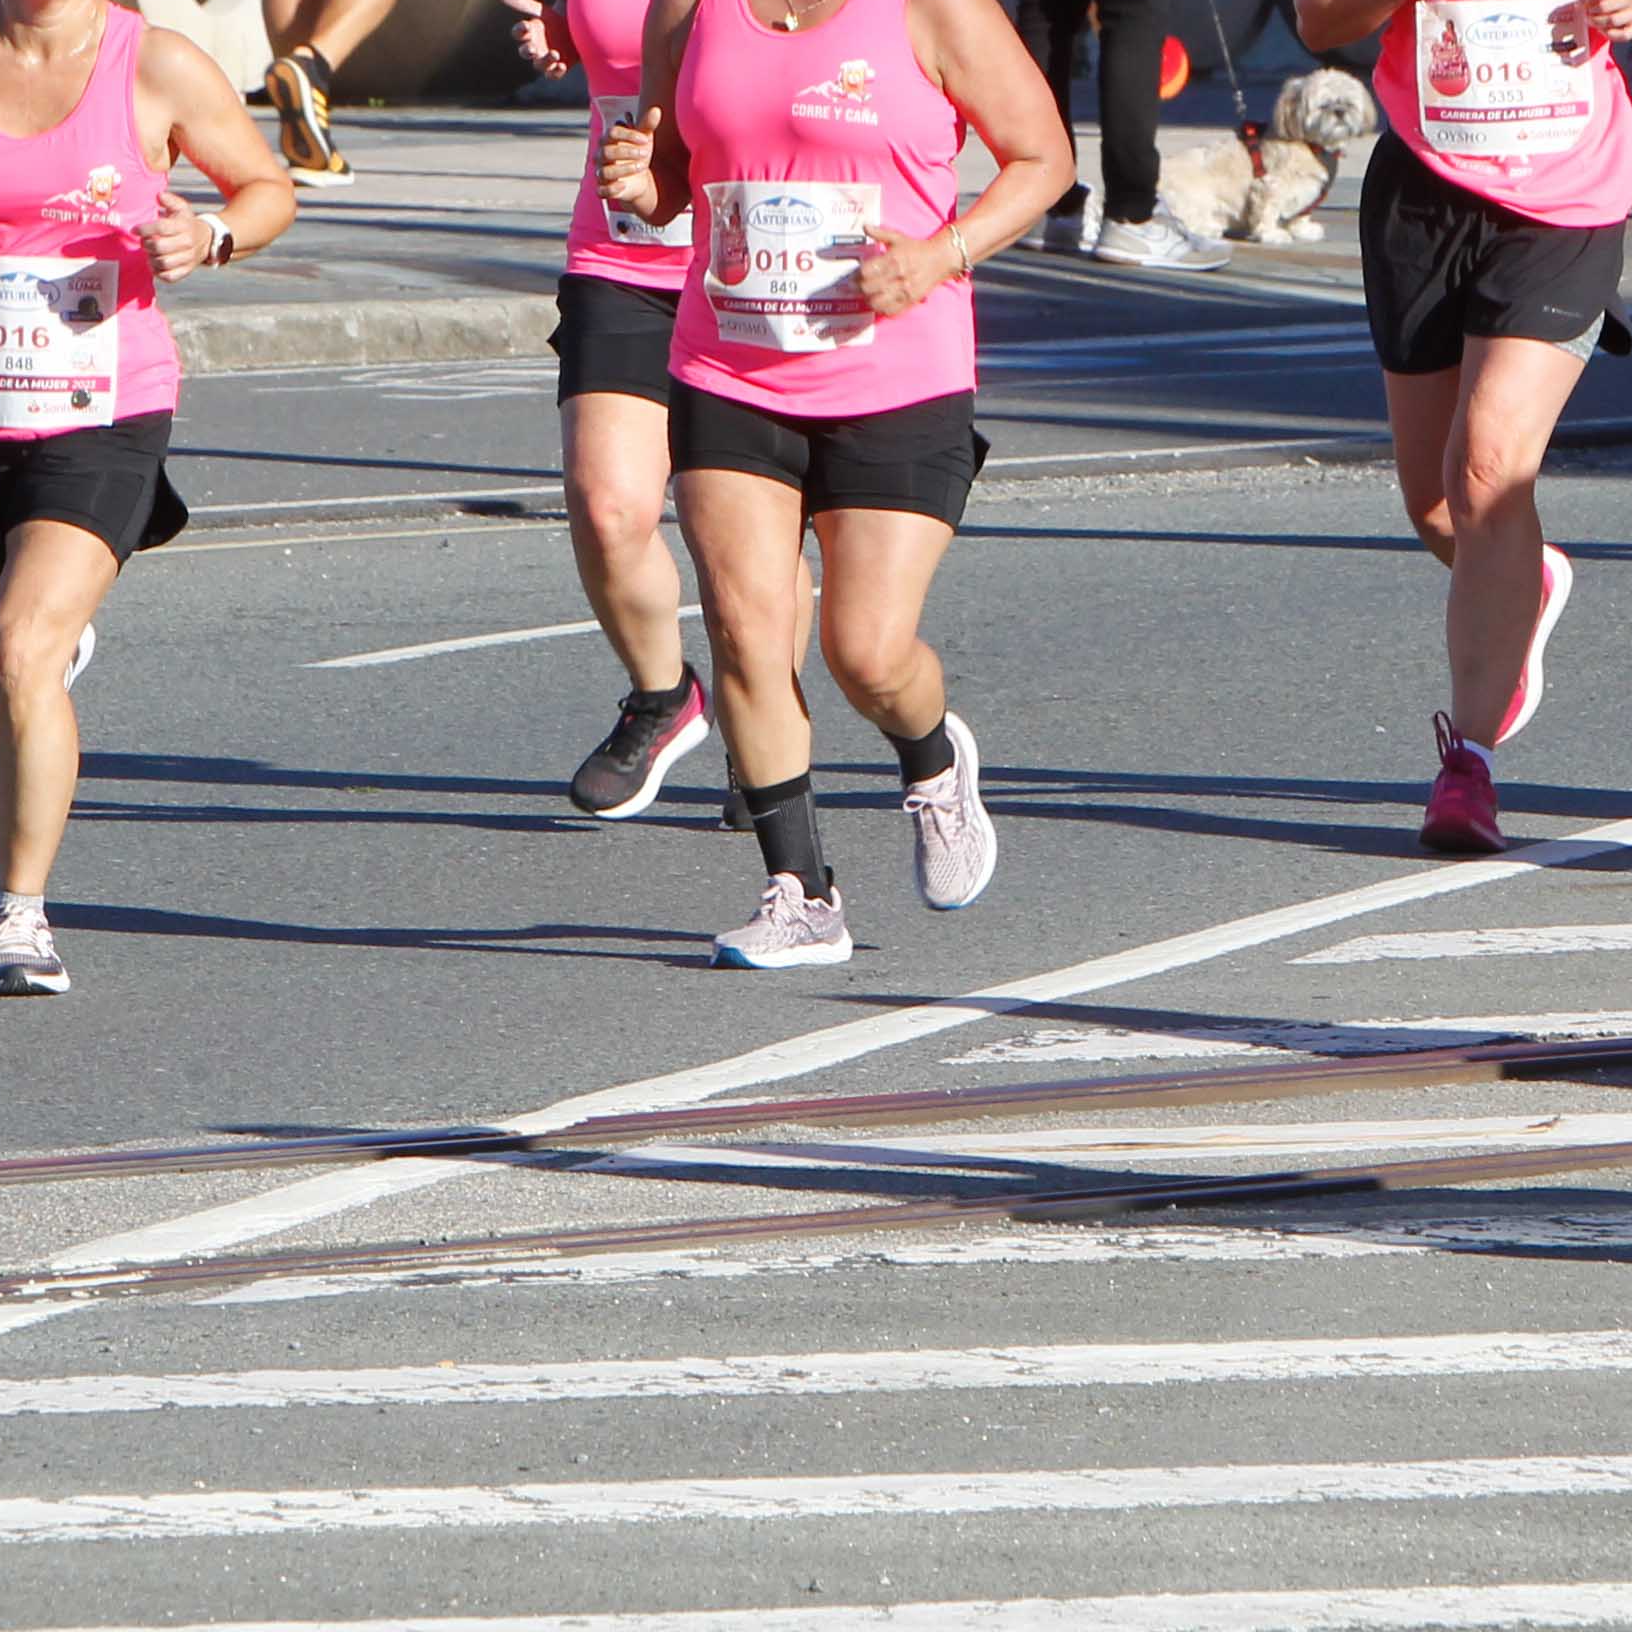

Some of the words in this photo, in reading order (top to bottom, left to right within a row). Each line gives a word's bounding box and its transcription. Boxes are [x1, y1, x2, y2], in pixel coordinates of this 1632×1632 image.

[1476, 61, 1533, 84] 016
[1488, 89, 1525, 104] 5353
[791, 103, 831, 120] CORRE
[833, 105, 843, 121] Y
[845, 107, 878, 127] CAÑA
[1440, 108, 1485, 121] CARRERA
[1486, 109, 1501, 121] DE
[1503, 108, 1517, 120] LA
[1518, 106, 1553, 119] MUJER
[1436, 129, 1487, 144] OYSHO
[752, 209, 818, 225] ASTURIANA
[629, 221, 666, 235] YSHO
[755, 249, 814, 272] 016
[770, 279, 798, 294] 849
[764, 302, 777, 312] DE
[779, 302, 794, 313] LA
[4, 355, 34, 371] 848
[0, 377, 13, 388] DE
[15, 378, 30, 390] LA
[31, 378, 69, 390] MUJER
